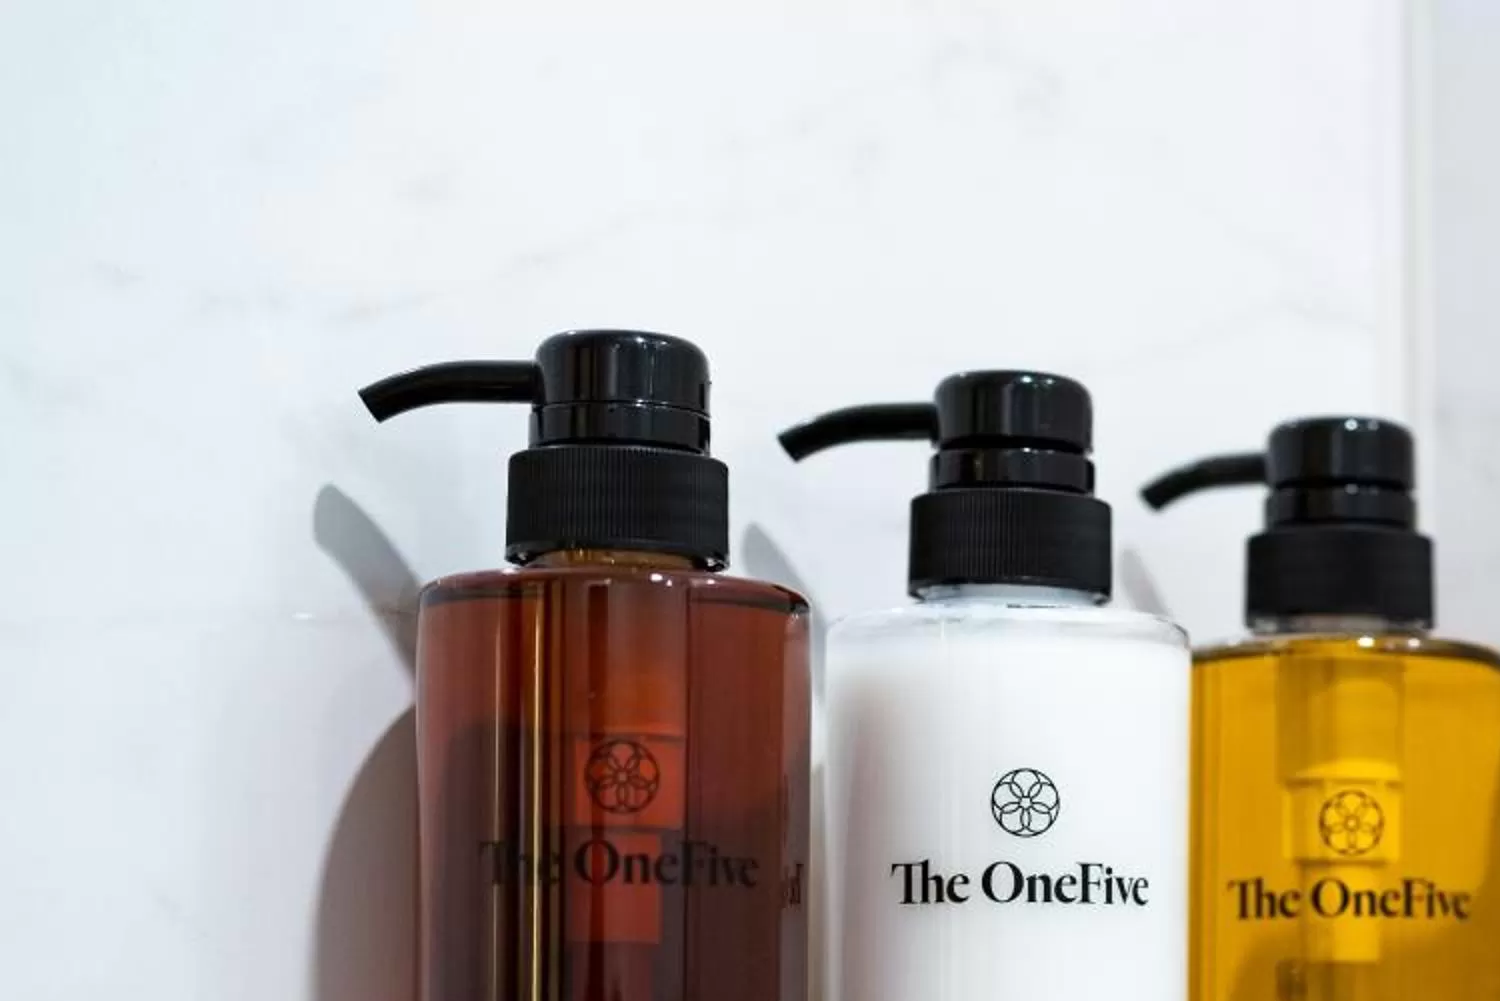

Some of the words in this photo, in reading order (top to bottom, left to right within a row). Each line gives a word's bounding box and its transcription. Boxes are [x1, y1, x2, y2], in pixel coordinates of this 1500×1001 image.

[574, 839, 760, 888] OneFive
[890, 859, 970, 904] The
[981, 861, 1149, 906] OneFive
[1227, 877, 1303, 920] The
[1311, 877, 1470, 920] OneFive
